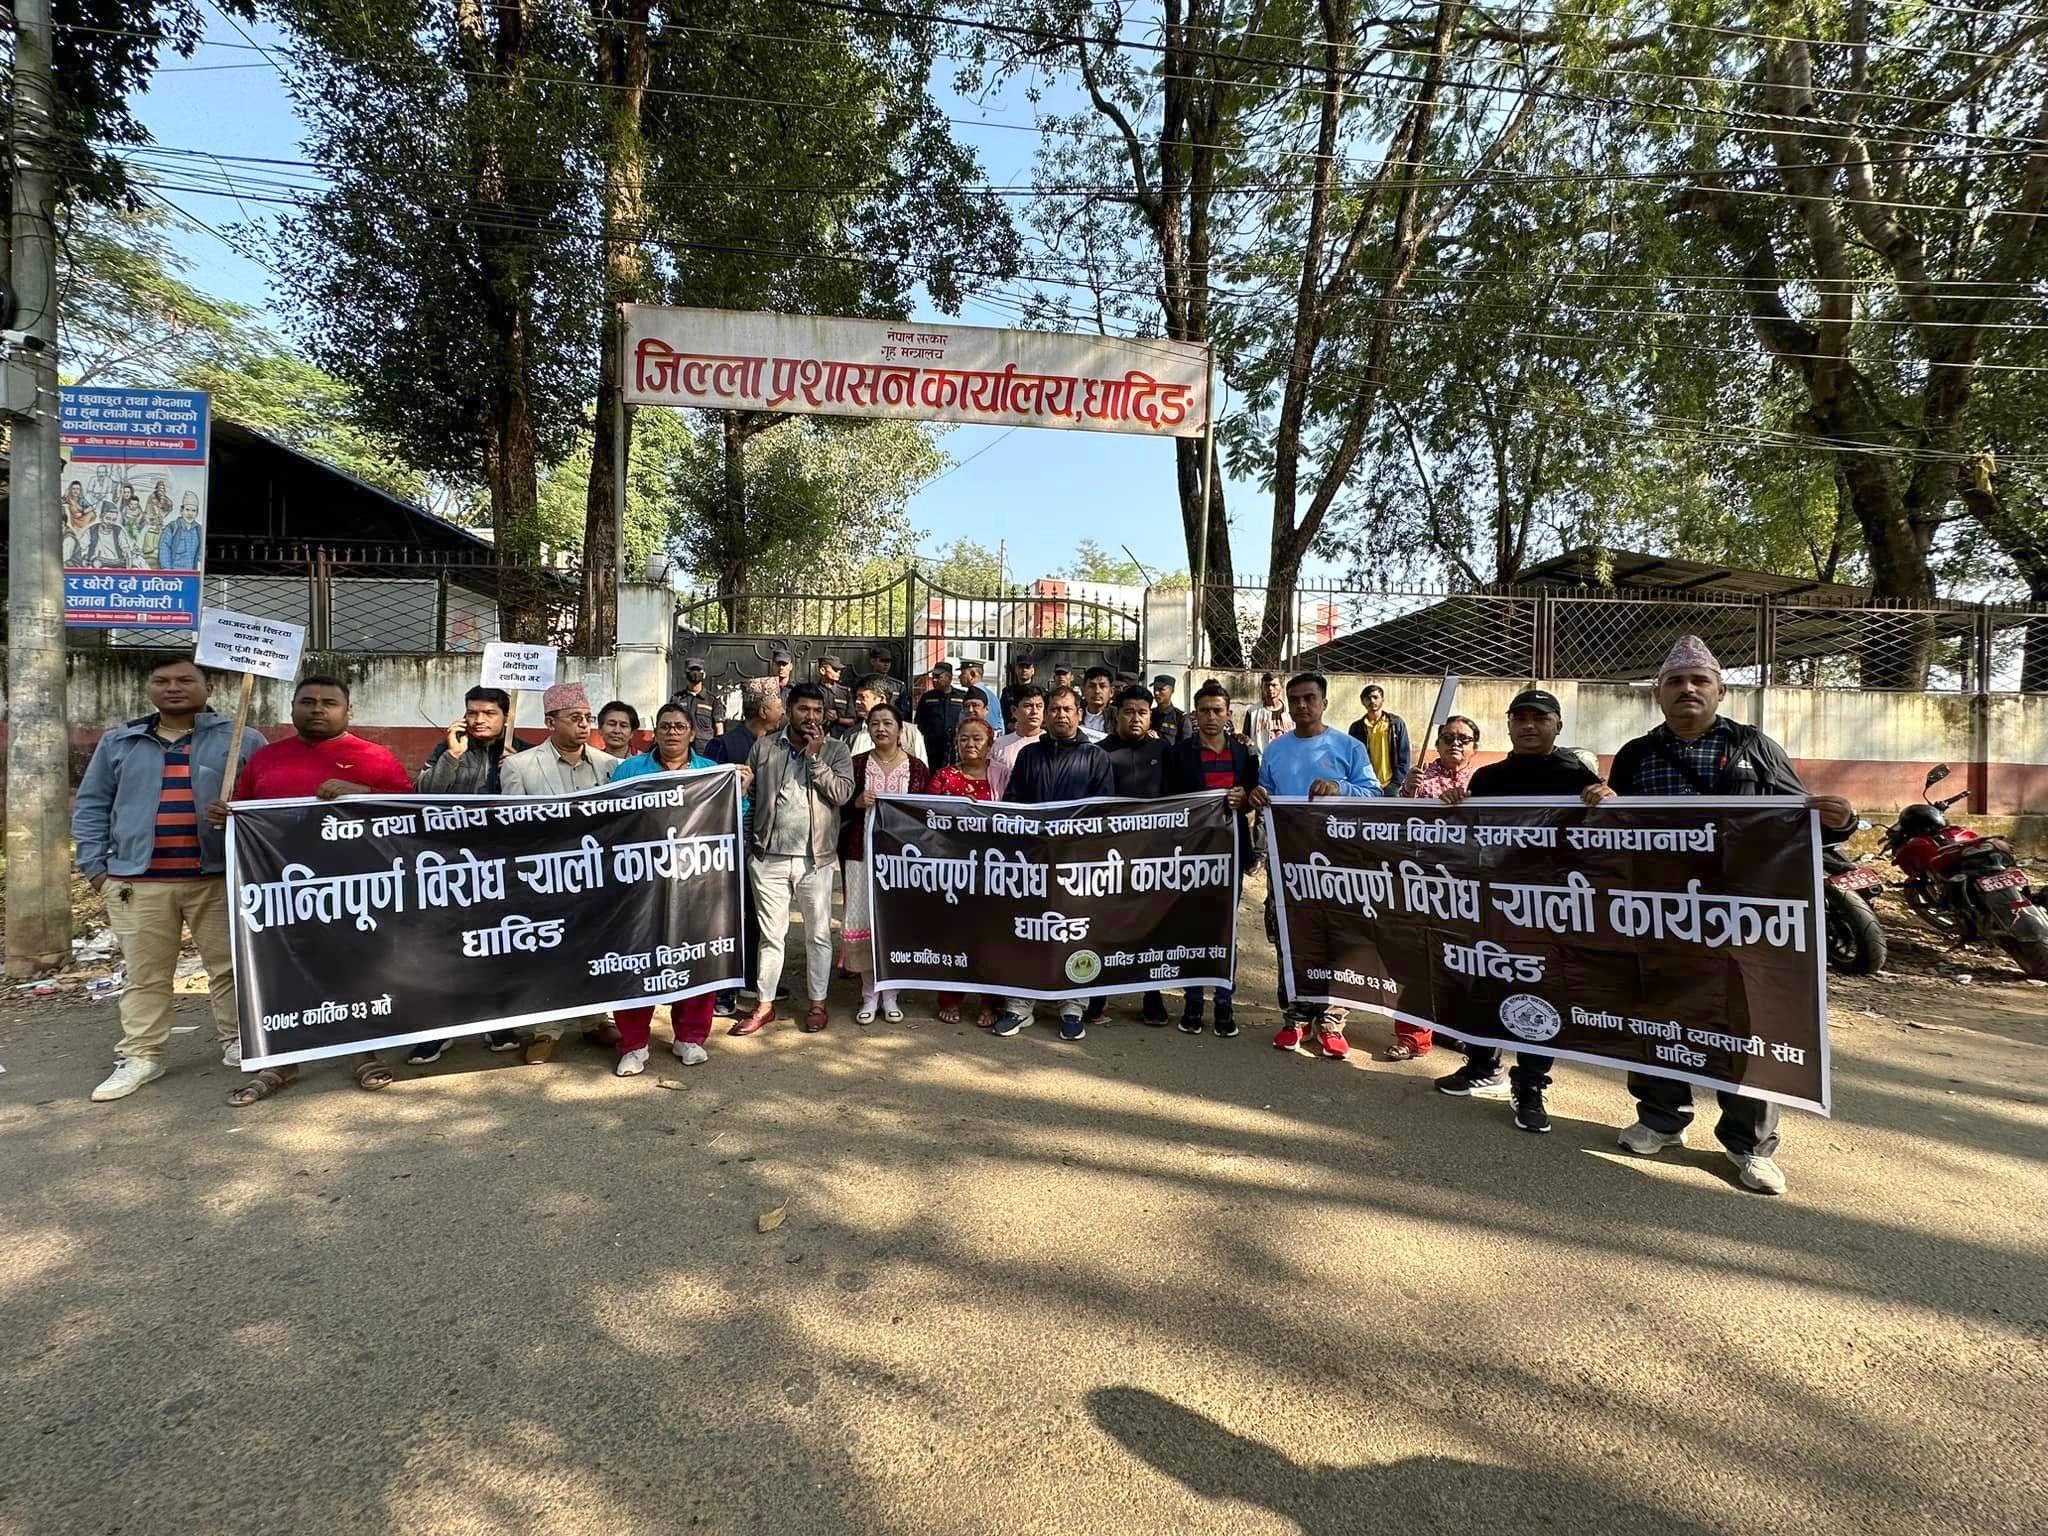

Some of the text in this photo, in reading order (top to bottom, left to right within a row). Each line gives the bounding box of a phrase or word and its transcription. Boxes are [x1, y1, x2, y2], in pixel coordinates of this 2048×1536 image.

[917, 333, 948, 345] सरकार
[881, 346, 944, 361] गृह मन्त्रालय
[634, 338, 767, 400] जिल्ला
[766, 357, 921, 408] प्रशासन
[80, 408, 100, 419] हुन
[103, 408, 142, 420] लागेमा
[145, 408, 198, 421] नजिकको
[125, 396, 148, 406] तथा
[152, 395, 193, 408] भेदभाव
[62, 419, 128, 432] कार्यालयमा
[69, 578, 80, 590] र
[83, 576, 114, 590] छोरी
[142, 576, 184, 592] प्रतिको
[66, 595, 106, 607] समान
[110, 593, 173, 609] जिम्मेवारी
[371, 814, 416, 838] तथा
[422, 805, 488, 832] वित्तीय
[956, 815, 987, 833] तथा
[992, 813, 1041, 835] वित्तीय
[1045, 816, 1102, 835] समस्या
[1108, 808, 1190, 833] समाधानार्थ
[1361, 820, 1400, 843] तथा
[1405, 816, 1467, 846] वित्तीय
[1473, 823, 1557, 849] समस्या
[1566, 821, 1717, 853] समाधानार्थ
[240, 857, 406, 933] शान्तिपूर्ण
[416, 848, 506, 910] विरोध
[612, 827, 736, 884] कार्यक्रम
[875, 843, 978, 904] शान्तिपूर्ण
[984, 848, 1049, 898] विरोध
[1130, 846, 1231, 892] कार्यक्रम
[1283, 851, 1395, 919] शान्तिपूर्ण
[1399, 863, 1481, 923] विरोध
[1608, 878, 1809, 954] कार्यक्रम
[587, 936, 735, 977] अधिकृत विक्रेता संघ
[913, 948, 941, 965] कार्तिक
[941, 954, 953, 967] २३
[954, 952, 969, 968] गते
[1137, 948, 1164, 965] उद्योग
[1166, 945, 1205, 961] वाणिज्य
[1208, 944, 1227, 959] संघ
[1333, 968, 1365, 986] कार्तिक
[1366, 977, 1380, 990] २३
[1382, 978, 1398, 994] गते
[263, 994, 393, 1031] २०७९ कार्तिक २३ गते
[1571, 1006, 1624, 1031] निर्माण
[1628, 1018, 1683, 1042] सामग्री
[1687, 1027, 1766, 1057] व्यवसायी
[1771, 1041, 1805, 1066] संघ
